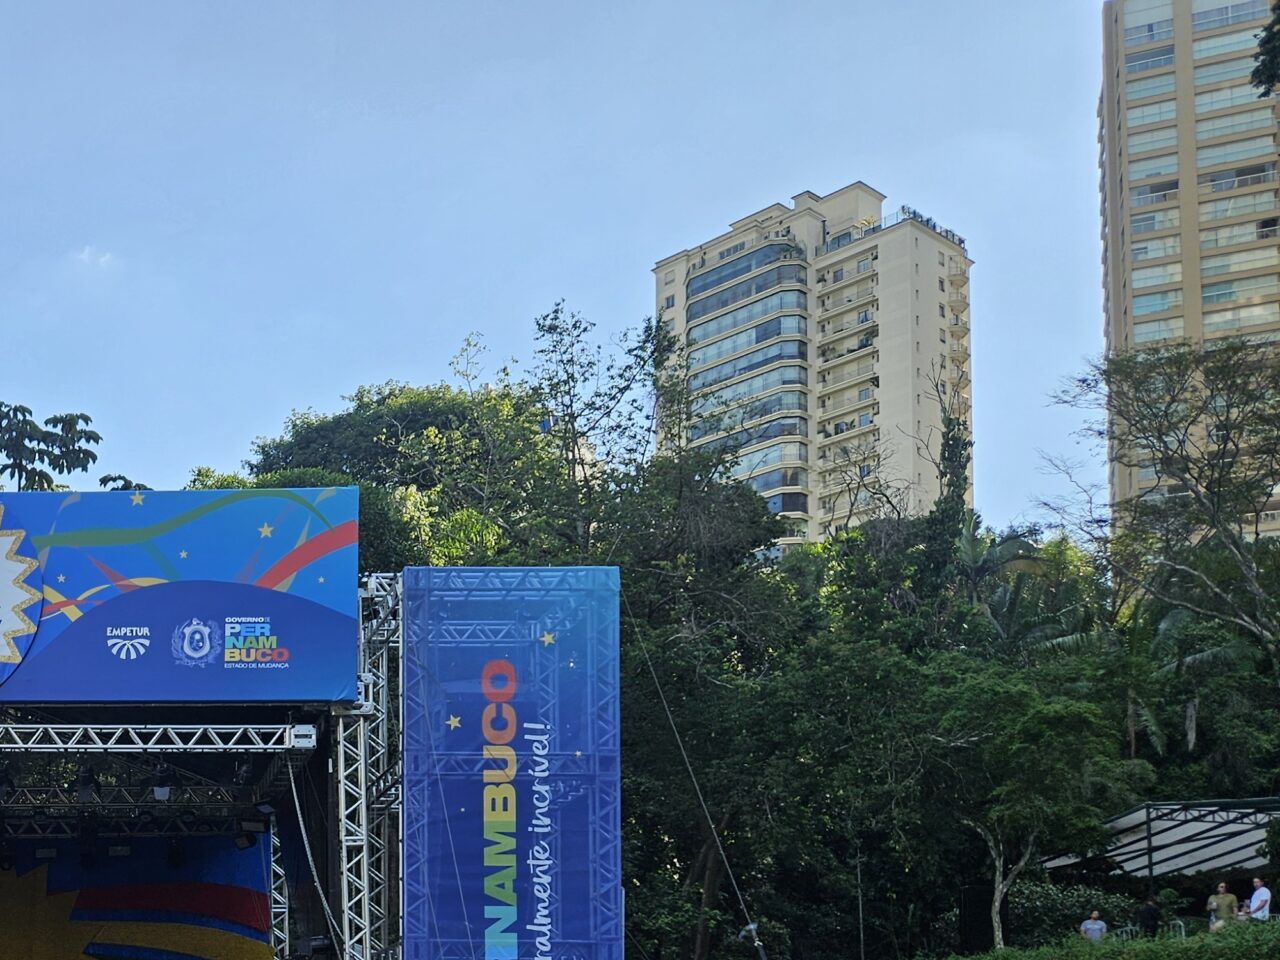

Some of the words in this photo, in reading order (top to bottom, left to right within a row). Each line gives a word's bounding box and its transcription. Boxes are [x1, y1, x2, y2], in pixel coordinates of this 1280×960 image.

[106, 626, 150, 636] EMPETUR
[224, 624, 270, 636] PER
[224, 636, 277, 648] NAM
[224, 648, 290, 662] BUCO
